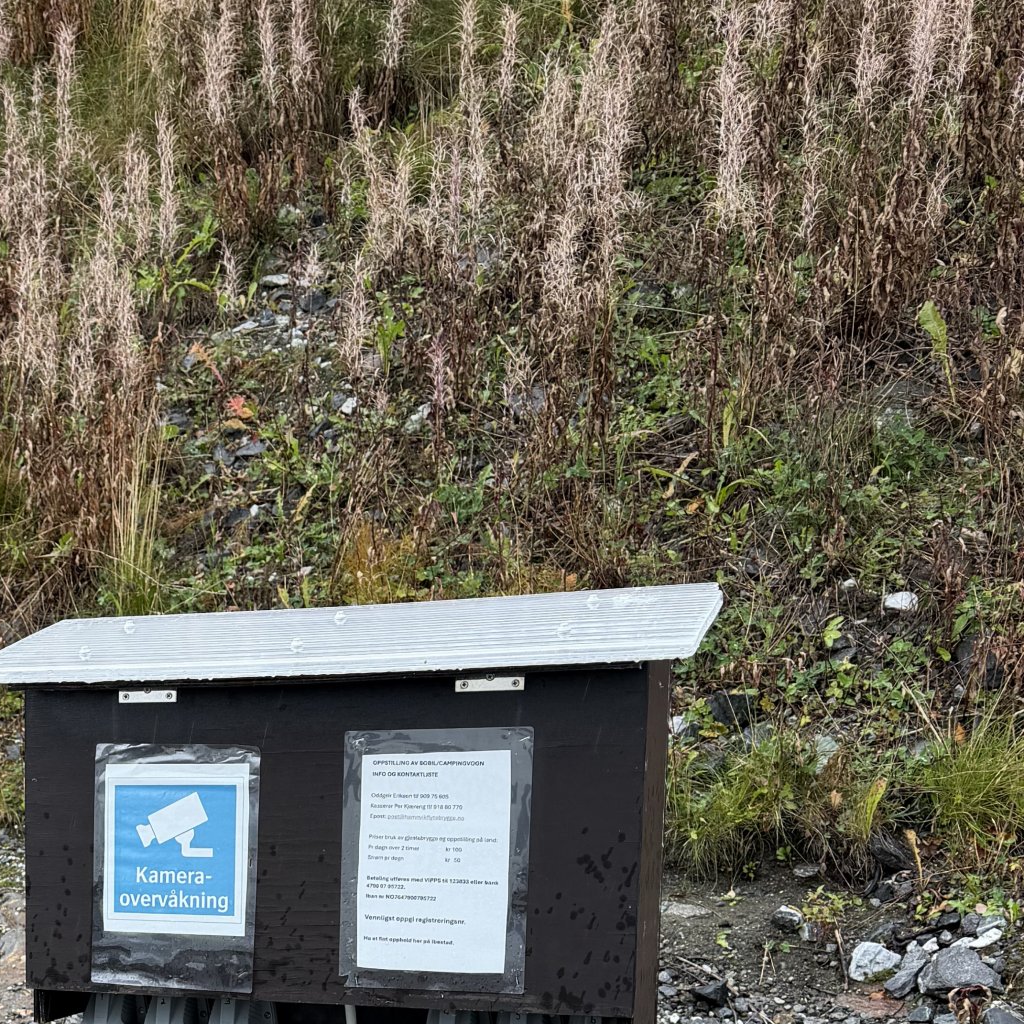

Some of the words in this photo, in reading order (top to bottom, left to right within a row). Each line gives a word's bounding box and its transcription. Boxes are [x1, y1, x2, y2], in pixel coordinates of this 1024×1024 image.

[136, 866, 213, 885] Kamera-
[119, 890, 229, 912] overvåkning
[364, 914, 395, 922] Vennligst
[396, 915, 415, 923] oppgi
[416, 916, 466, 925] registreringsnr.
